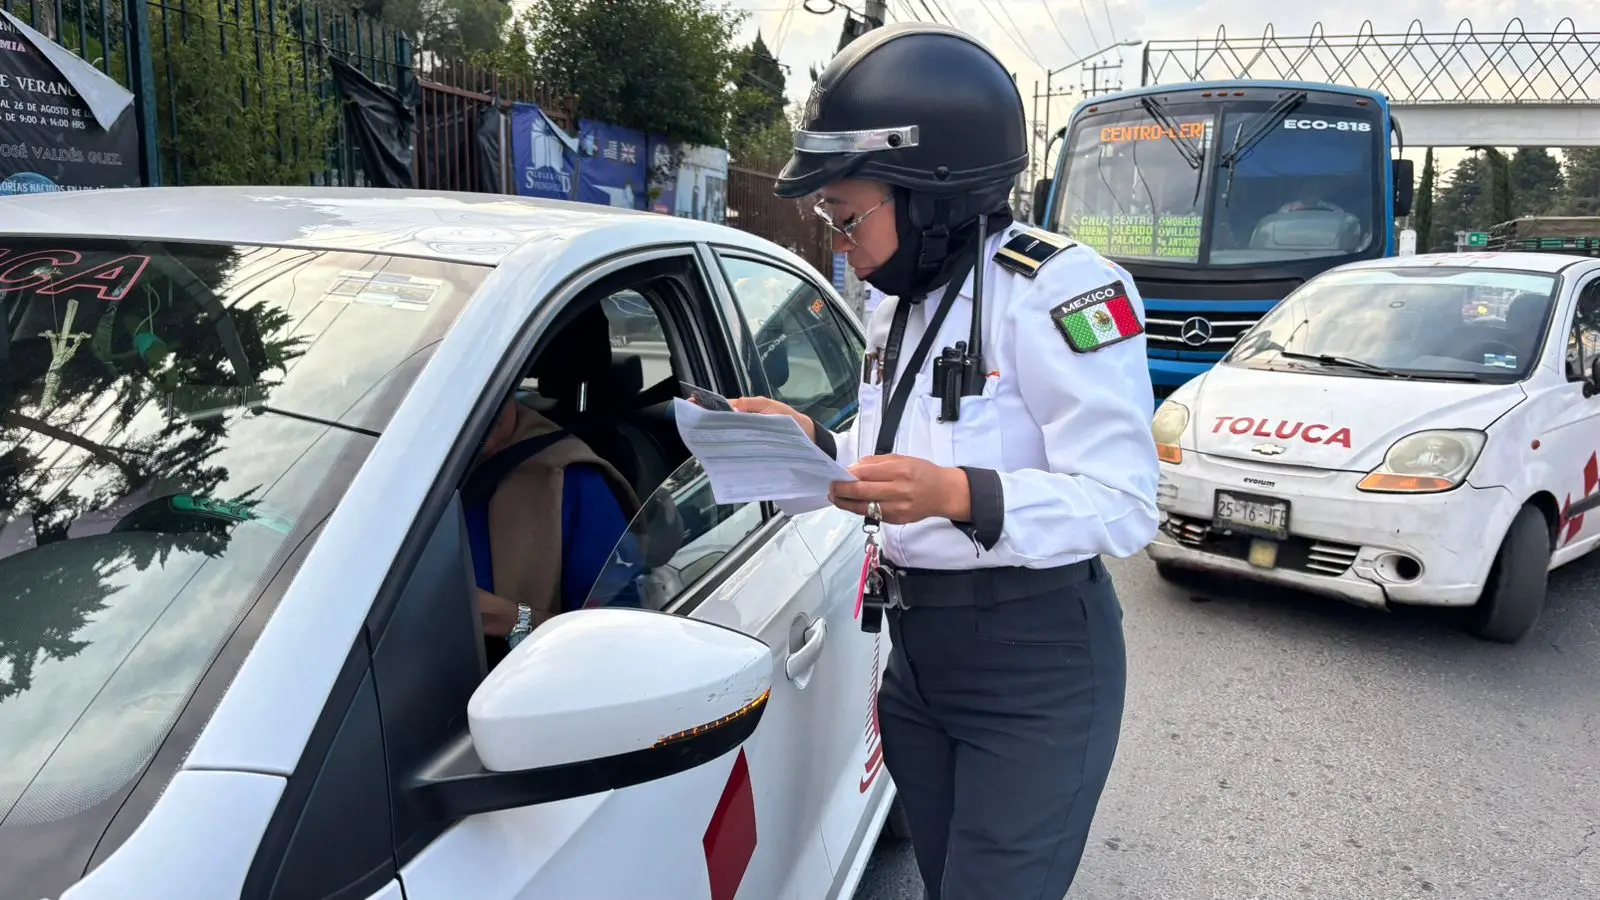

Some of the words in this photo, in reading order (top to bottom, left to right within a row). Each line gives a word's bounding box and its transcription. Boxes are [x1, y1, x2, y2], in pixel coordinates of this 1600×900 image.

[14, 101, 24, 110] 26
[27, 103, 37, 112] DE
[41, 105, 69, 115] AGOSTO
[72, 109, 81, 117] DE
[6, 113, 16, 121] DE
[20, 115, 37, 124] 9:00
[41, 117, 47, 125] A
[72, 121, 86, 129] HRS
[1283, 119, 1372, 132] ECO-818
[0, 181, 28, 192] ORÍAS
[1112, 215, 1154, 226] CENTRO
[1110, 235, 1153, 245] PALACIO
[0, 249, 151, 300] CA
[1061, 288, 1114, 313] MEXICO
[1212, 416, 1352, 449] TOLUCA
